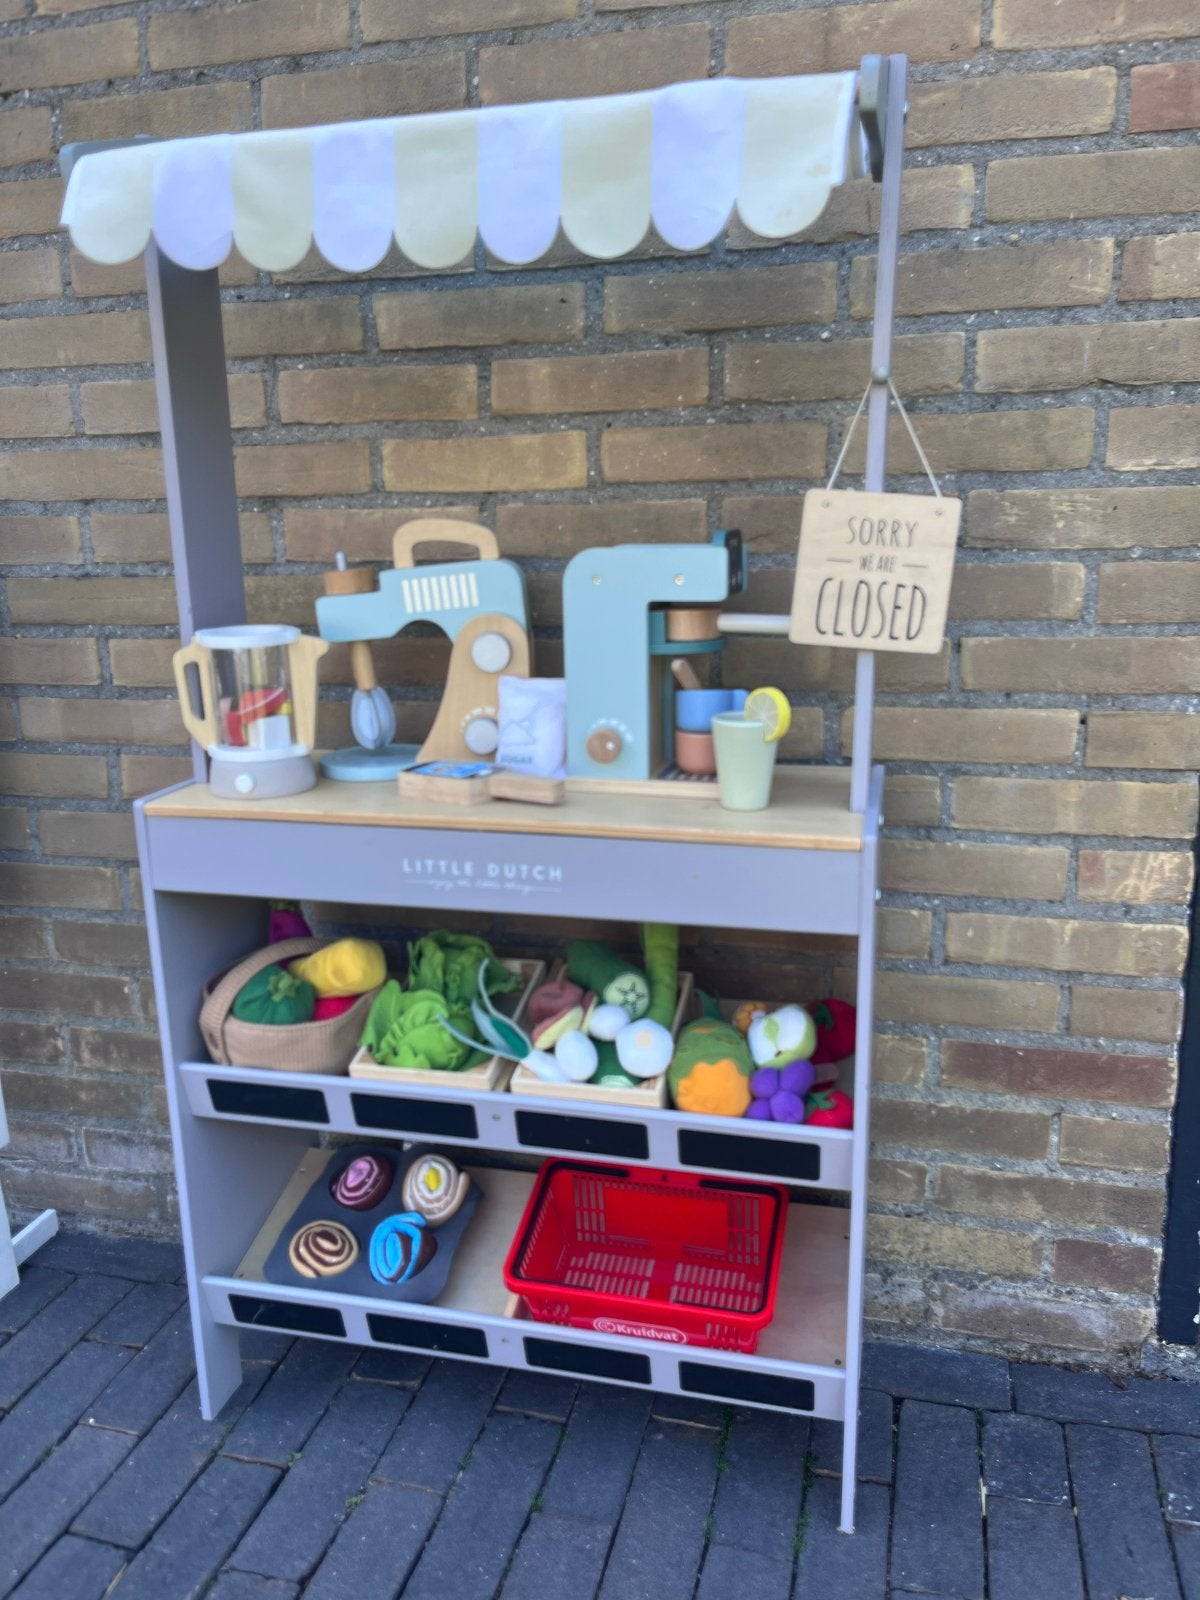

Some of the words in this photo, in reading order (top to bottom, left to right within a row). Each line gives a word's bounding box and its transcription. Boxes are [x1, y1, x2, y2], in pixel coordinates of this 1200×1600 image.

[847, 516, 919, 548] SORRY
[859, 555, 873, 571] WE
[875, 557, 896, 573] ARE
[815, 577, 927, 640] CLOSED
[402, 858, 473, 877] LITTLE
[487, 863, 562, 882] DUTCH
[616, 1323, 679, 1341] Kruidvat
